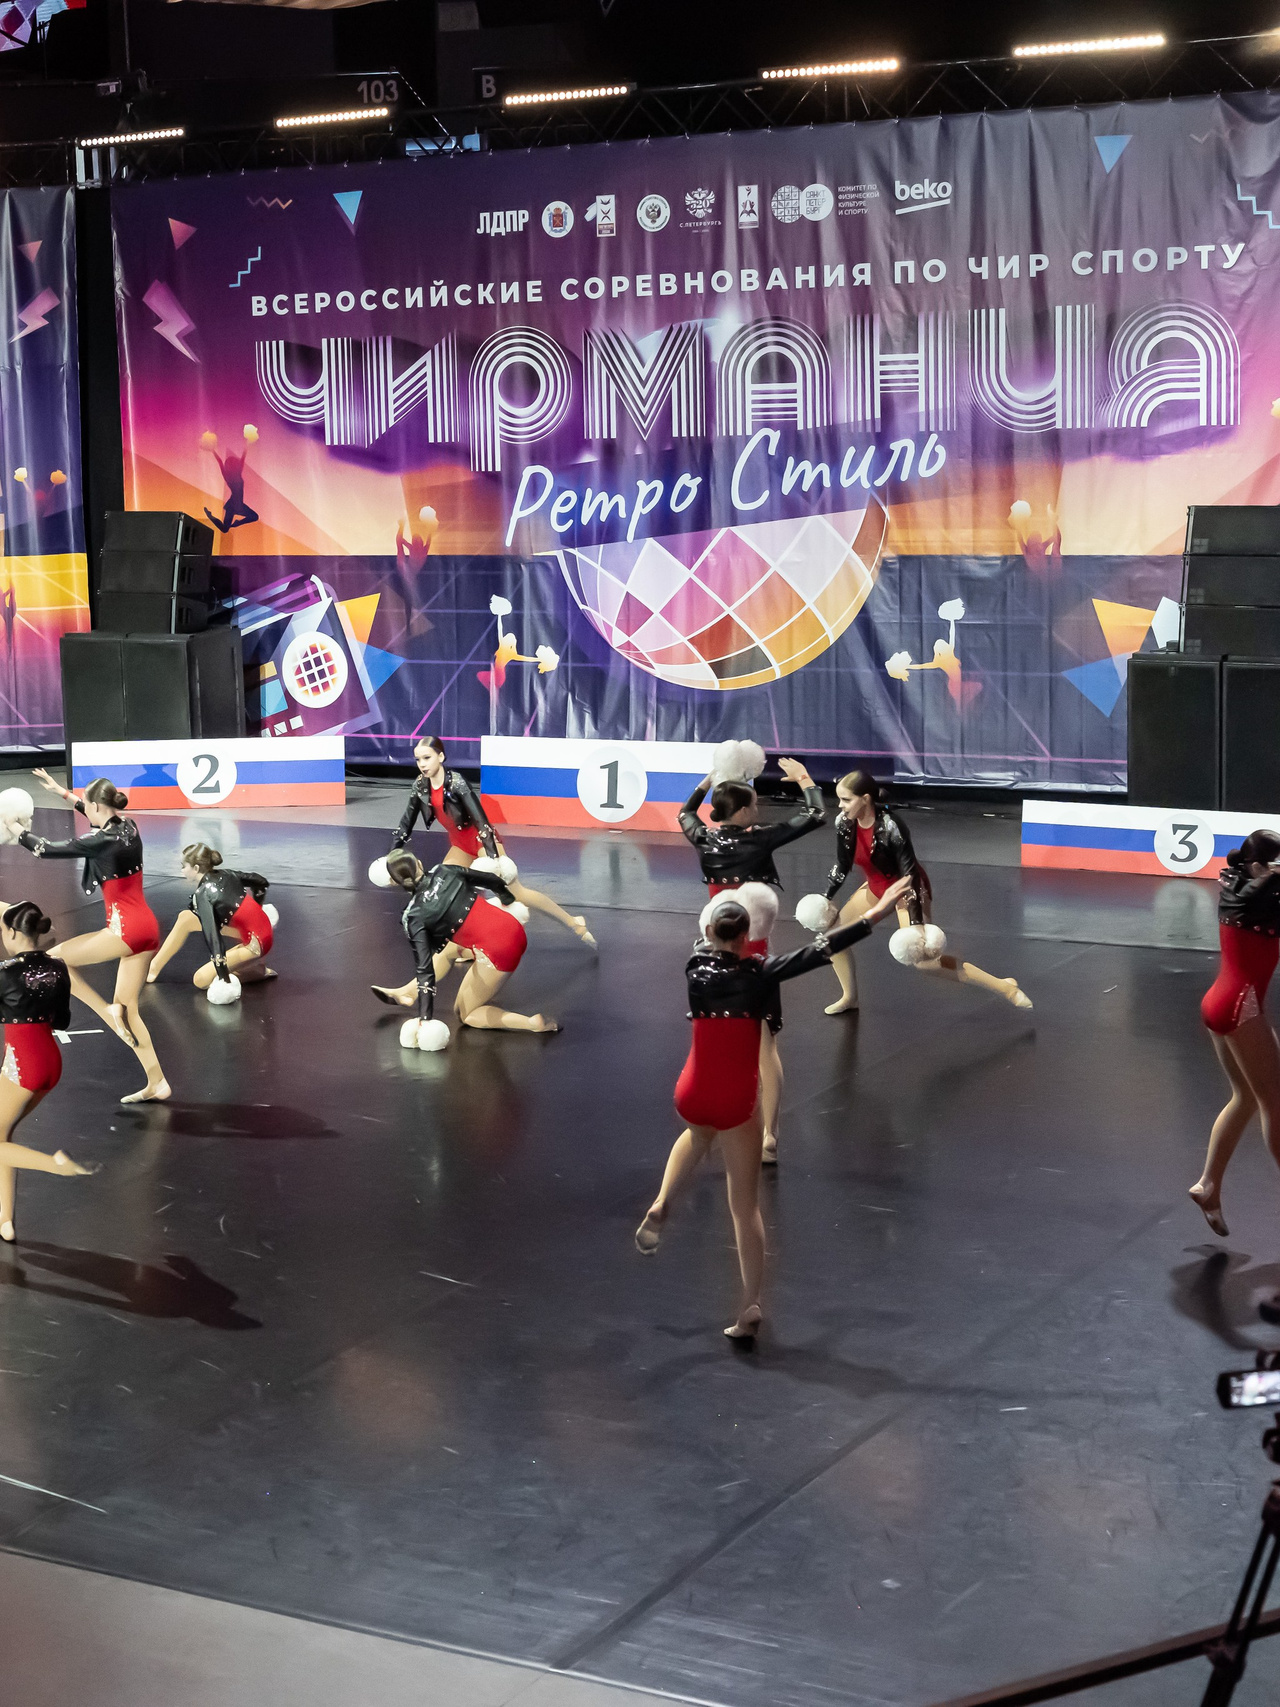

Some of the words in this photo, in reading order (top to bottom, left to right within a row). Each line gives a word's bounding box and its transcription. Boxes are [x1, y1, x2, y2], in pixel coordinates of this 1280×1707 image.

[357, 80, 398, 104] 103
[838, 191, 880, 200] ФИЗИЧЕСКОЙ
[894, 178, 952, 201] beko
[838, 200, 867, 208] КУЛЬТУРЕ
[844, 208, 868, 216] СПОРТУ
[477, 210, 529, 236] ЛДПР
[251, 279, 543, 317] ВСЕРОССИЙСКИЕ
[560, 261, 873, 300] СОРЕВНОВАНИЯ
[894, 259, 947, 284] ПО
[968, 254, 1050, 280] ЧИР
[1071, 243, 1246, 275] СПОРТУ
[504, 464, 702, 548] Ретро
[729, 427, 948, 511] Стиль
[191, 754, 221, 794] 2
[599, 760, 625, 808] 1
[1170, 823, 1198, 863] 3
